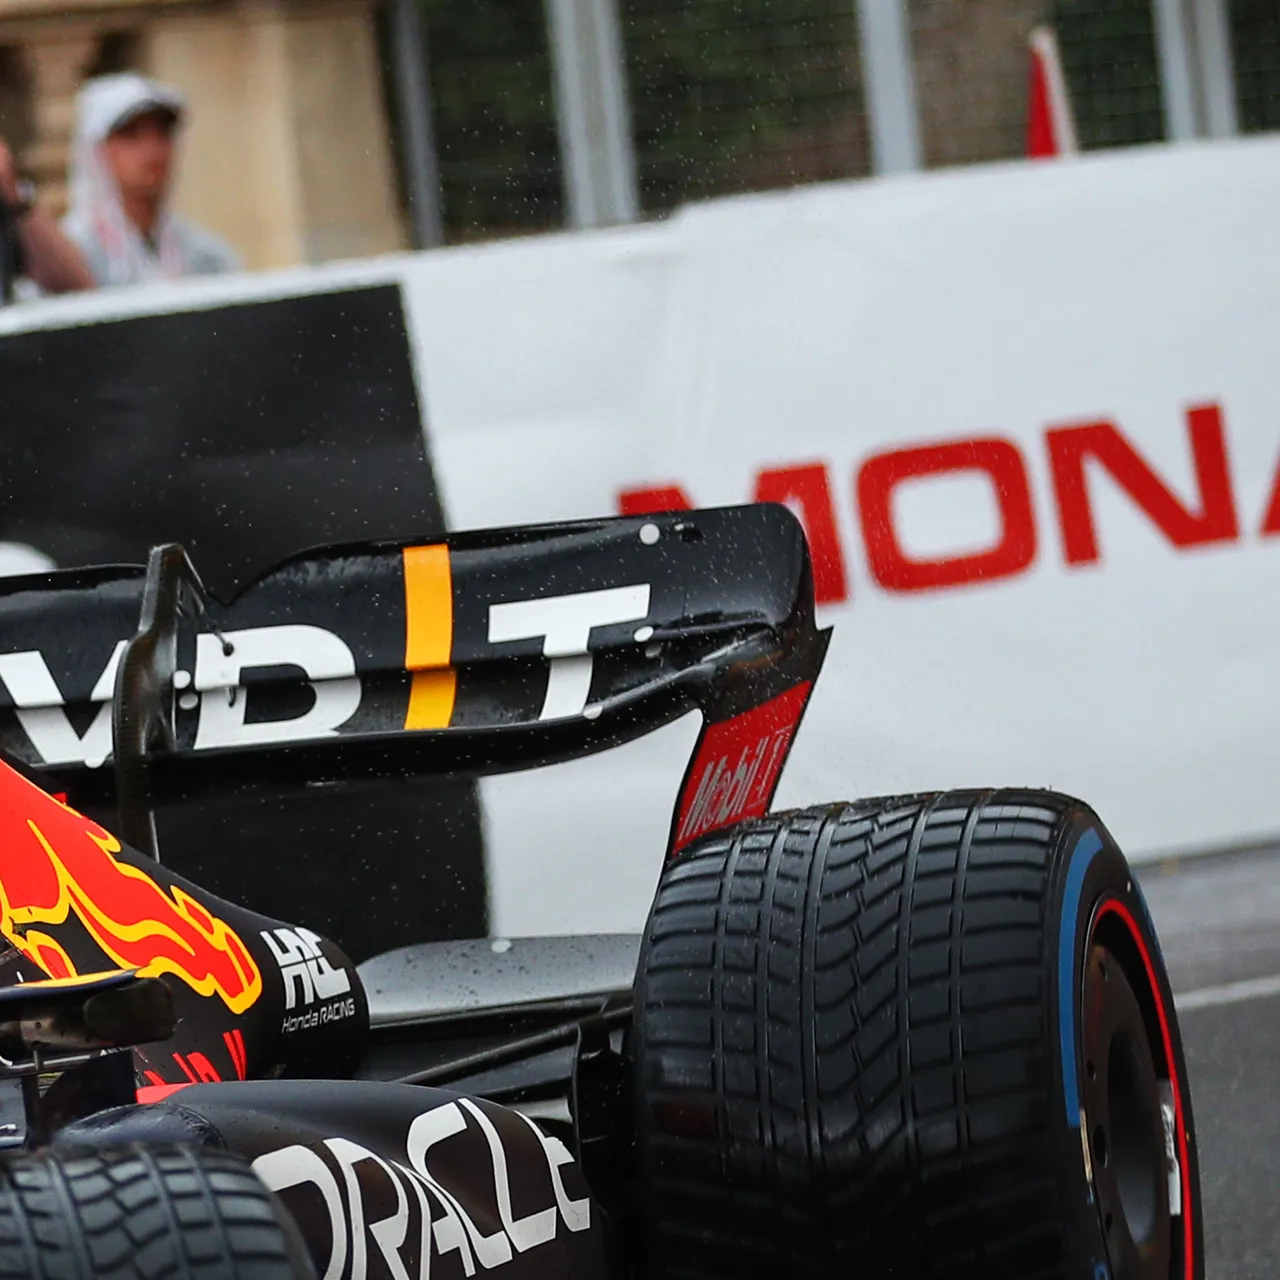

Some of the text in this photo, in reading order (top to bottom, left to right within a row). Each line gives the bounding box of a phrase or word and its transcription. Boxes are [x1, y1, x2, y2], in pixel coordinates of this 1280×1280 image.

[619, 398, 1280, 608] MON
[281, 997, 356, 1034] Honda RACING
